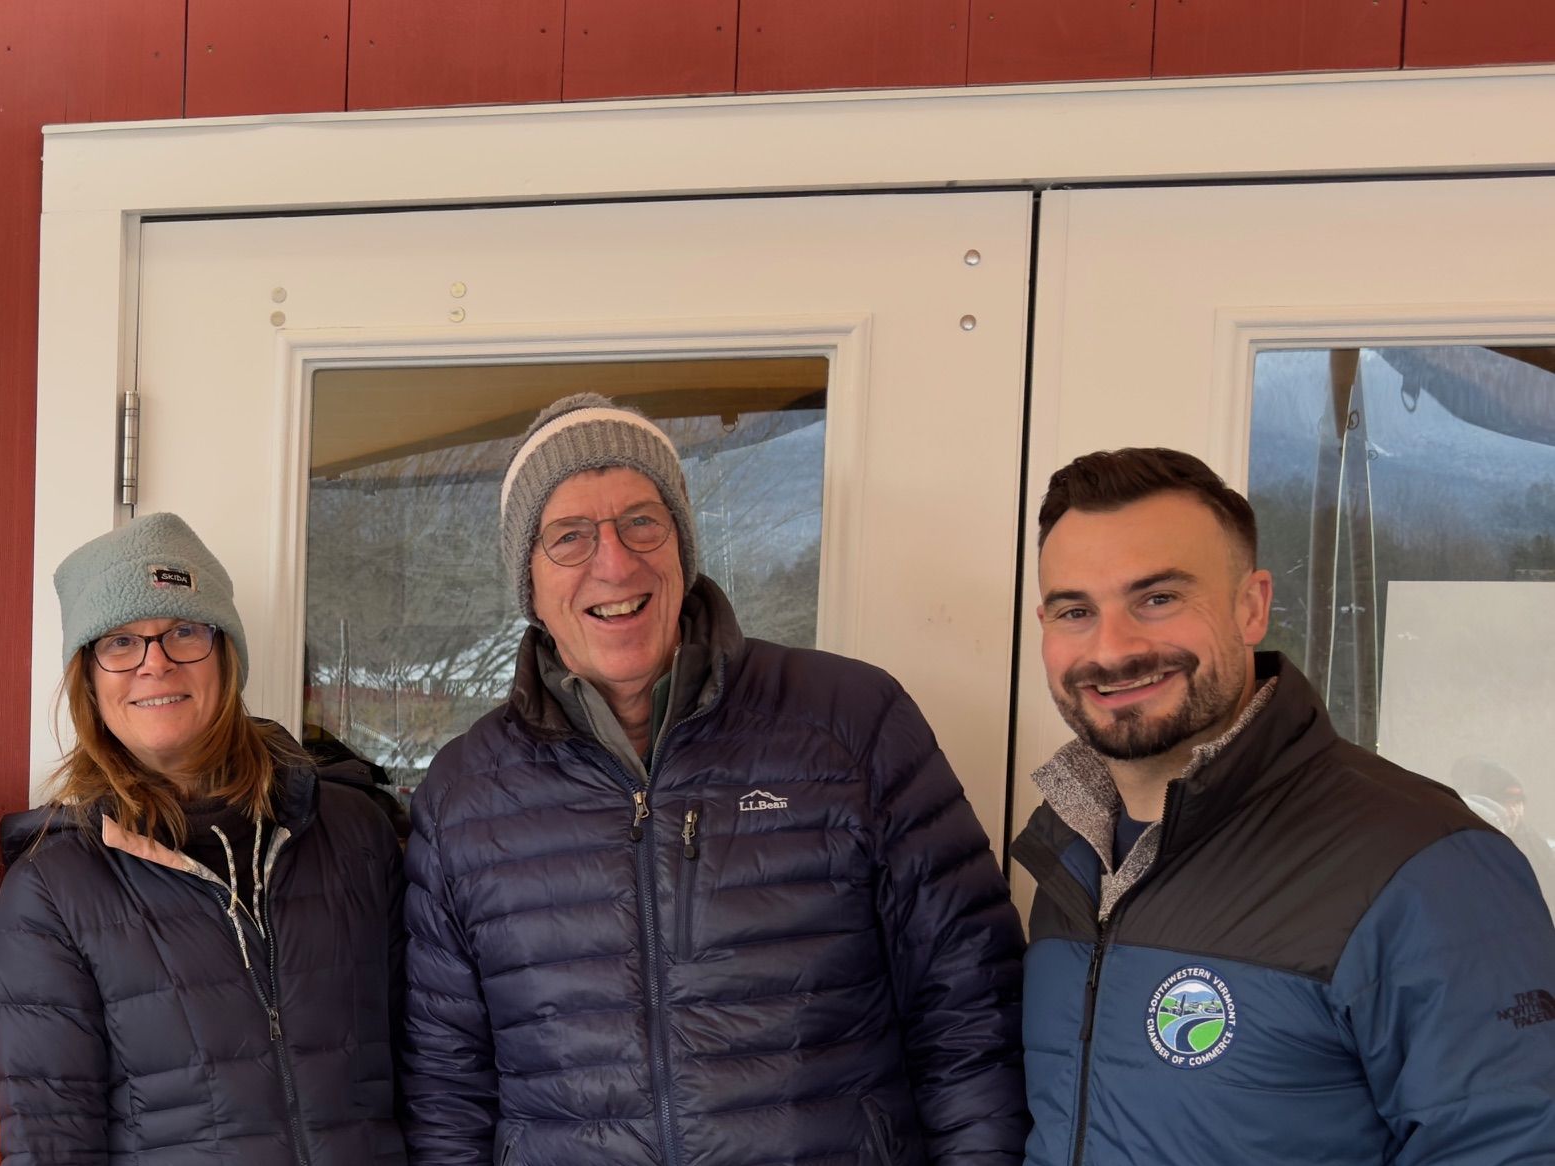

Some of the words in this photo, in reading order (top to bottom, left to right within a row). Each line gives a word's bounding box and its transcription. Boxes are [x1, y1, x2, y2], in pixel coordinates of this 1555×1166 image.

[1148, 968, 1211, 1013] SOUTHWESTERN
[1213, 976, 1236, 1026] VERMONT
[1146, 1018, 1170, 1060] CHAMBER
[1171, 1055, 1186, 1066] OF
[1188, 1031, 1234, 1067] COMMERCE
